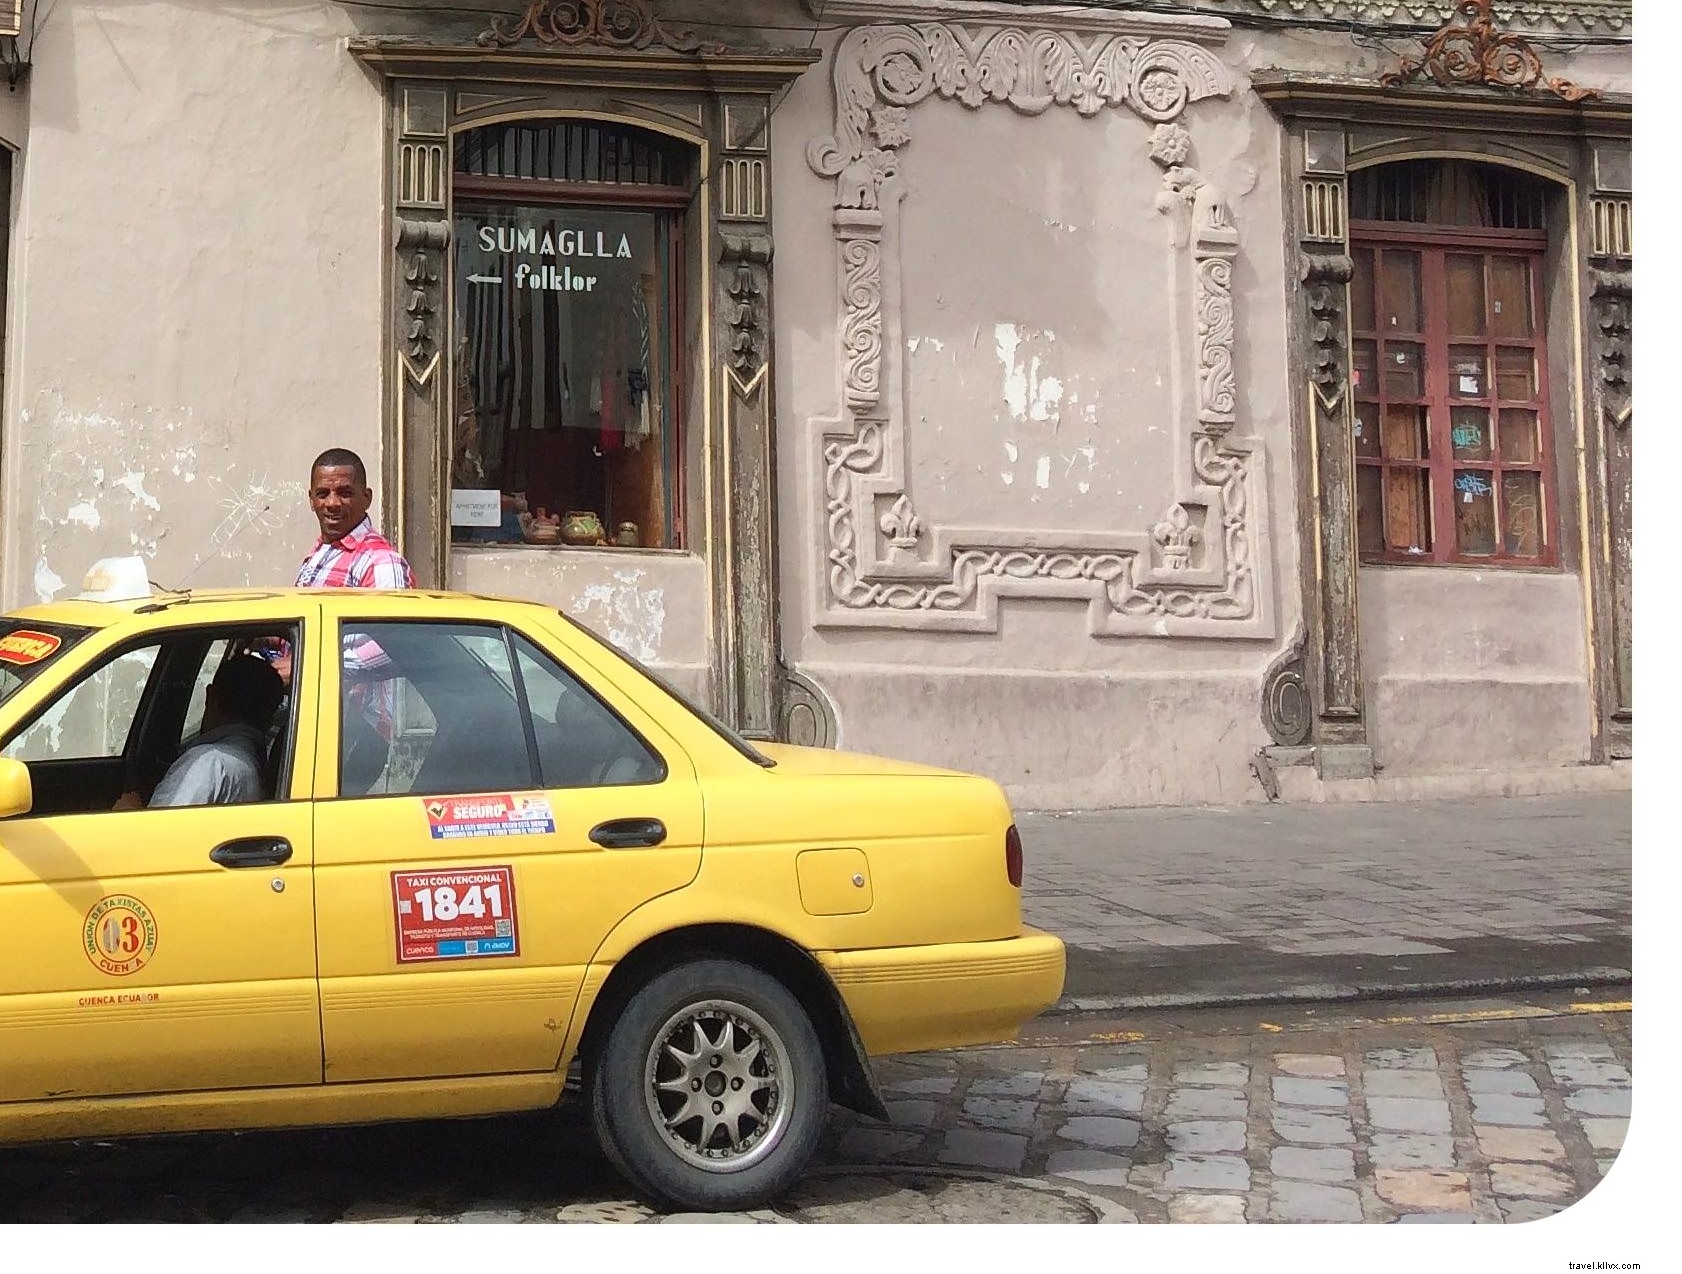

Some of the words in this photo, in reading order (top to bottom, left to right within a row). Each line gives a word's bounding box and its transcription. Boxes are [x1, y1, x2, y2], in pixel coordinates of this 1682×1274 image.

[479, 227, 632, 258] SUMAGLLA
[516, 264, 597, 291] folklor
[407, 877, 429, 888] TAXI
[430, 873, 502, 886] CONVENCIONAL
[415, 884, 503, 922] 1841
[92, 907, 104, 920] DE
[100, 958, 143, 972] CUENA
[79, 995, 115, 1006] CUENCA
[117, 992, 160, 1004] ECUAOR
